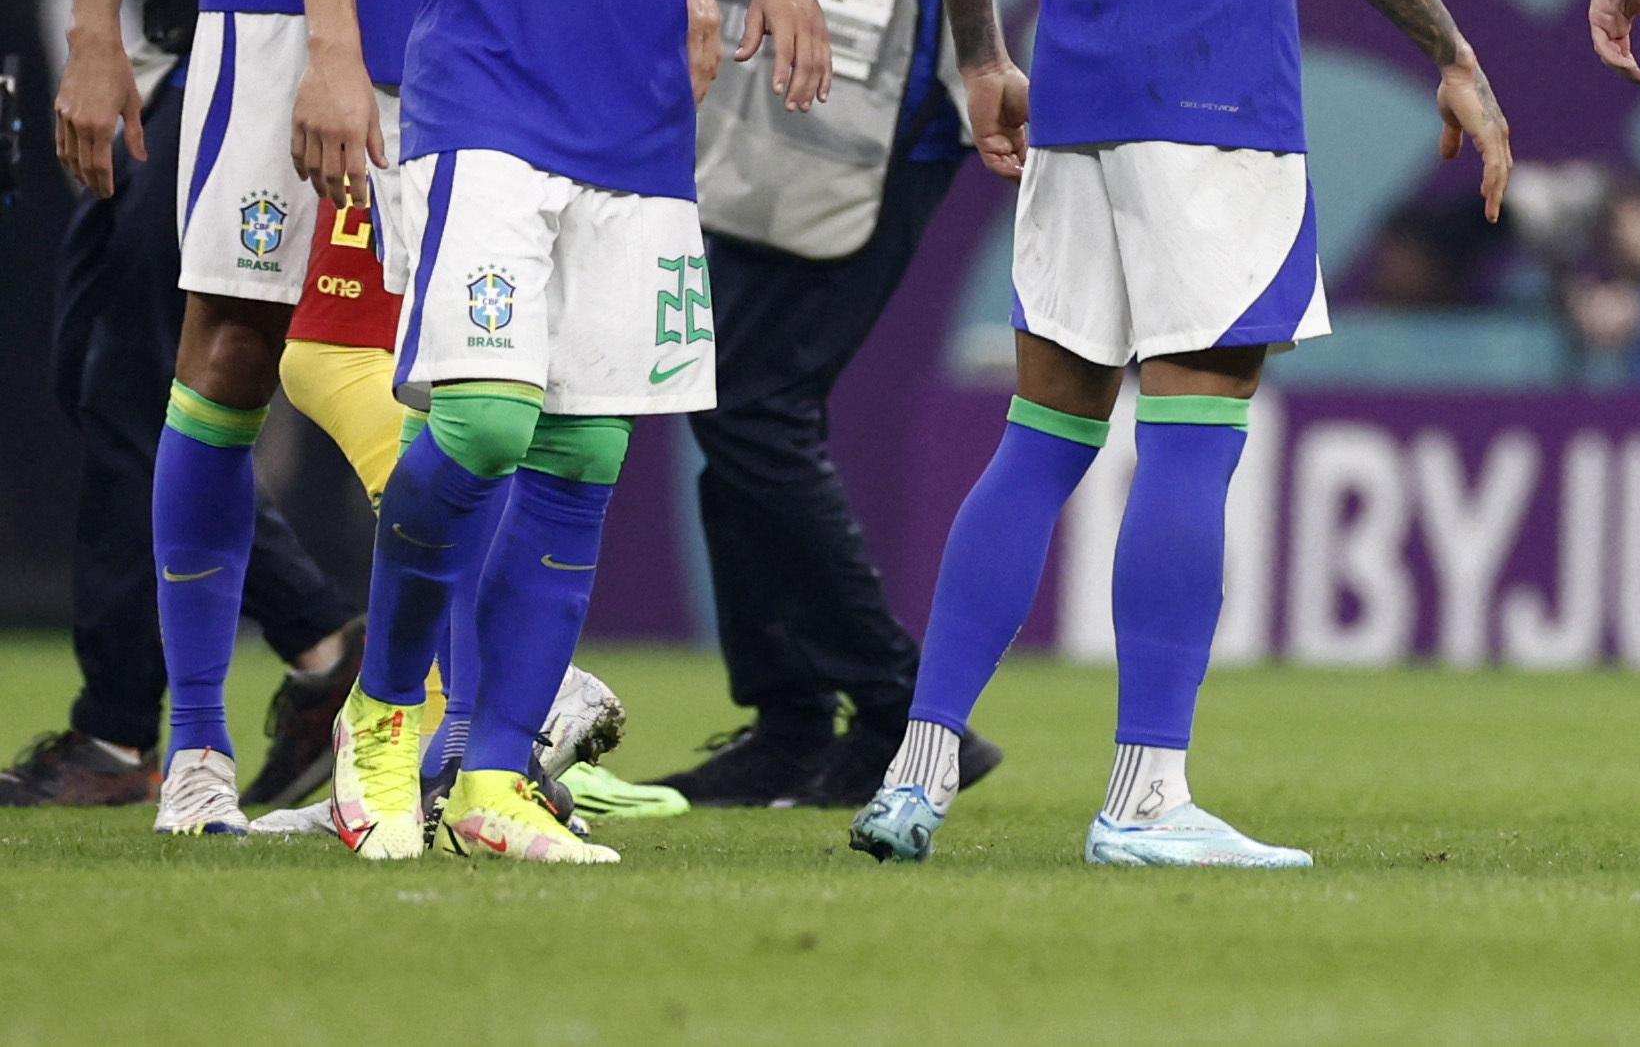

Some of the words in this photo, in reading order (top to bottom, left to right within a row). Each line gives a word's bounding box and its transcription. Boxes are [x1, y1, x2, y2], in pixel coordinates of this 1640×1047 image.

[253, 222, 271, 230] CBF
[237, 257, 282, 272] BRASIL
[317, 275, 362, 299] one
[482, 297, 499, 305] CBF
[655, 254, 713, 346] 22
[467, 336, 515, 349] BRASIL
